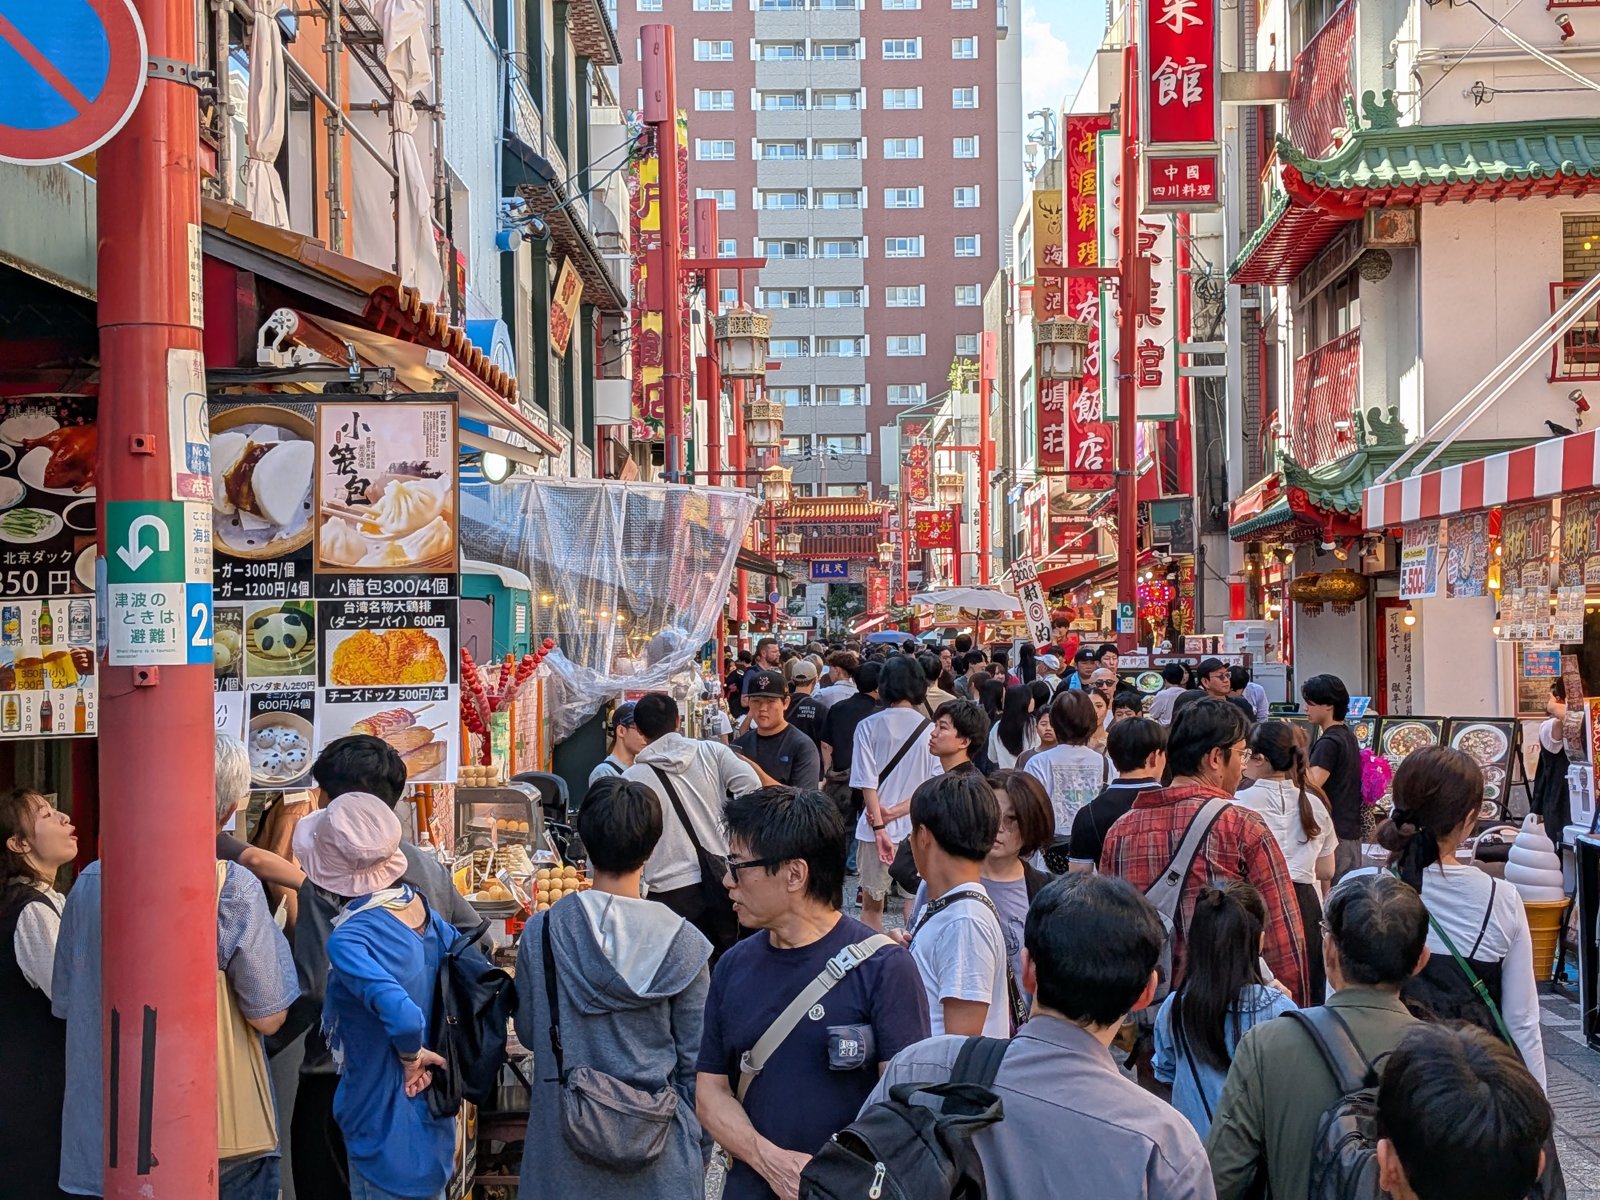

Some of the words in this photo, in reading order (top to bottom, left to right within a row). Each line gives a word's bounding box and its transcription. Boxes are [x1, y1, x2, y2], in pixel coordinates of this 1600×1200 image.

[1164, 164, 1200, 181] 中國
[1152, 183, 1213, 197] 四川料理
[3, 549, 72, 565] 北京ダック
[0, 570, 39, 594] 50
[49, 571, 71, 594] 円
[329, 577, 449, 596] 小籠包300/4個
[115, 592, 167, 607] 津波の
[57, 607, 65, 642] 400円
[123, 611, 175, 625] ときは
[413, 615, 445, 627] 600円
[130, 628, 176, 644] 避難！
[17, 680, 45, 690] 500円
[246, 681, 316, 691] パンダまん250円
[329, 690, 396, 702] チーズドック
[398, 689, 446, 701] 500円/本
[87, 692, 95, 730] 300円
[258, 698, 311, 710] 600円/4個
[58, 693, 66, 731] 300円
